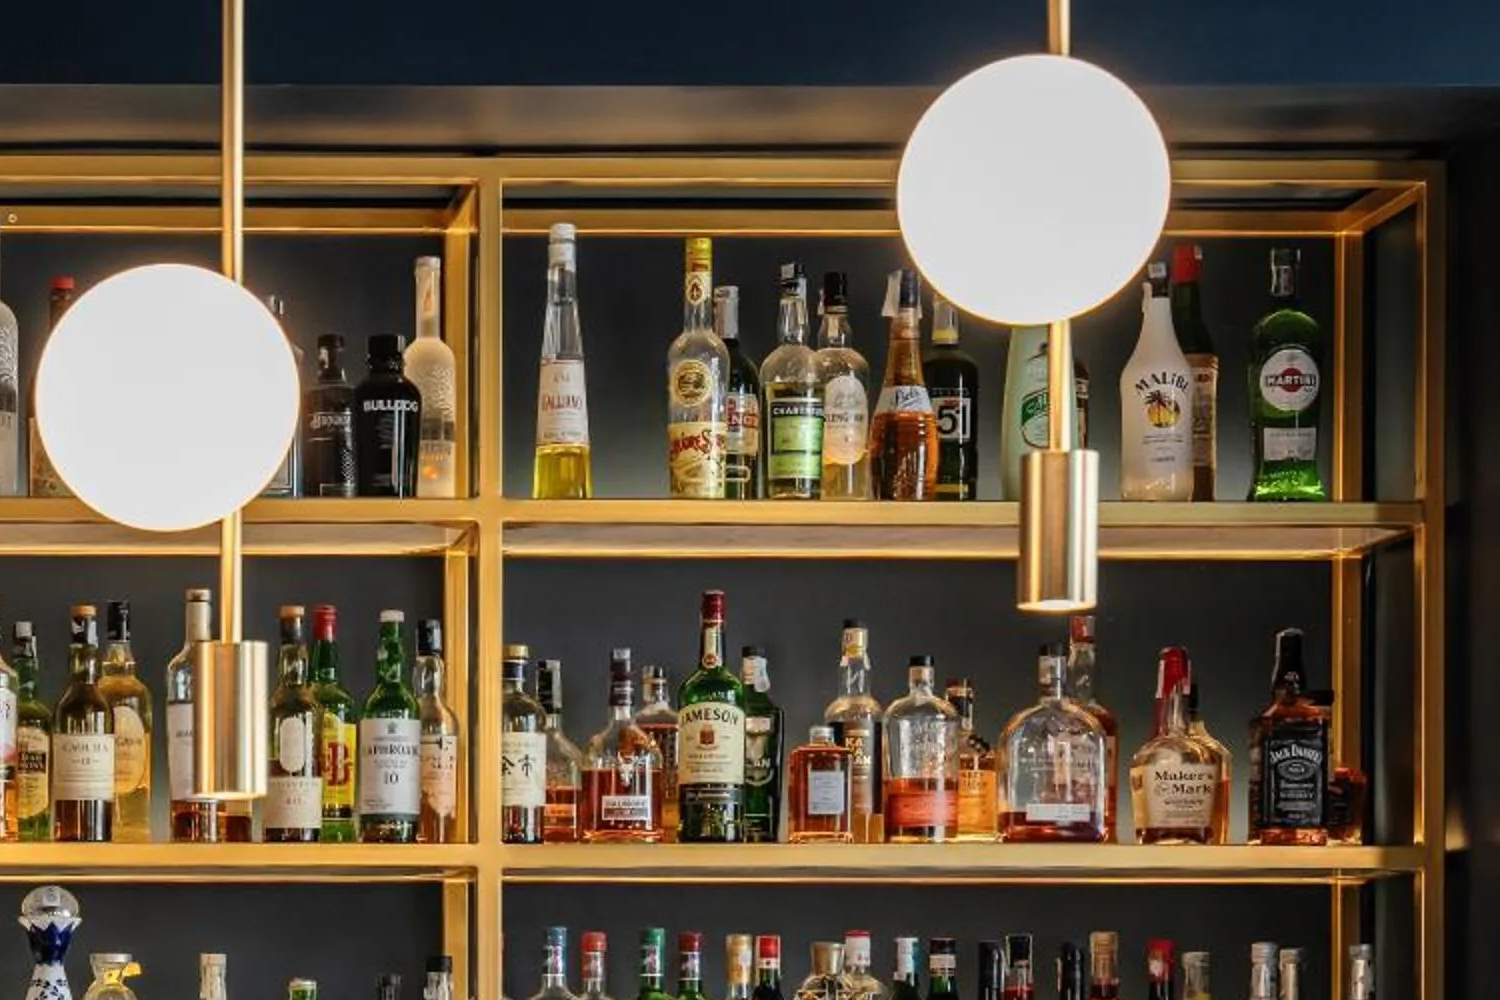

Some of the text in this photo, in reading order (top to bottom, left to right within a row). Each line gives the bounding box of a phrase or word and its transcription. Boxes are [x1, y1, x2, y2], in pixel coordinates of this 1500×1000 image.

[1265, 375, 1314, 387] MARTINI
[364, 400, 418, 411] BULLDOG
[937, 401, 968, 435] 51
[680, 707, 738, 725] JAMESON
[383, 772, 398, 786] 10
[1172, 783, 1212, 796] Mark
